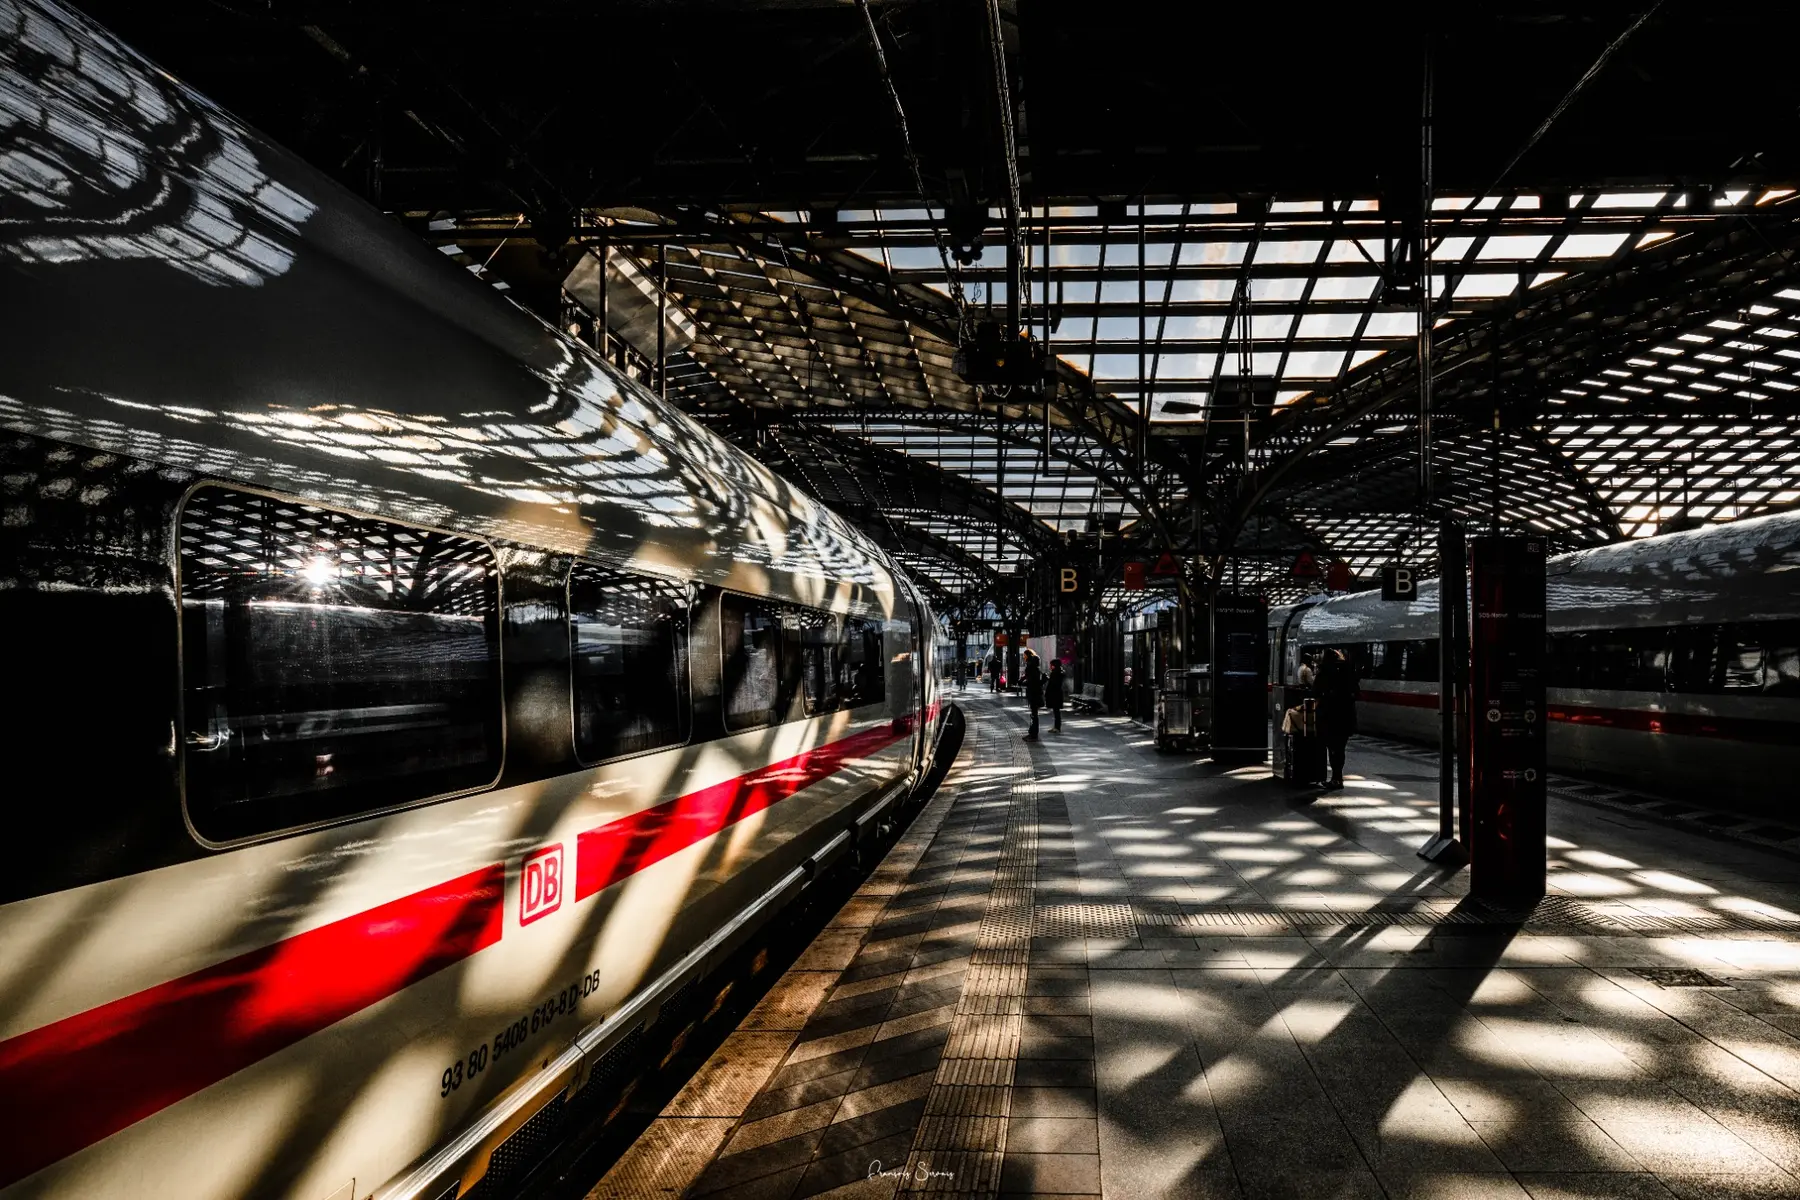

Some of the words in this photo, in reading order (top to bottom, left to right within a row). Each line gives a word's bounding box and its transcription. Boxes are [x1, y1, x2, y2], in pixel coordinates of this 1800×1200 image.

[1060, 568, 1079, 592] B
[1395, 569, 1412, 593] B
[526, 856, 558, 913] DB
[441, 1060, 463, 1098] 93
[467, 1044, 488, 1079] 80
[492, 1016, 528, 1062] 5408
[531, 990, 567, 1034] 613-8
